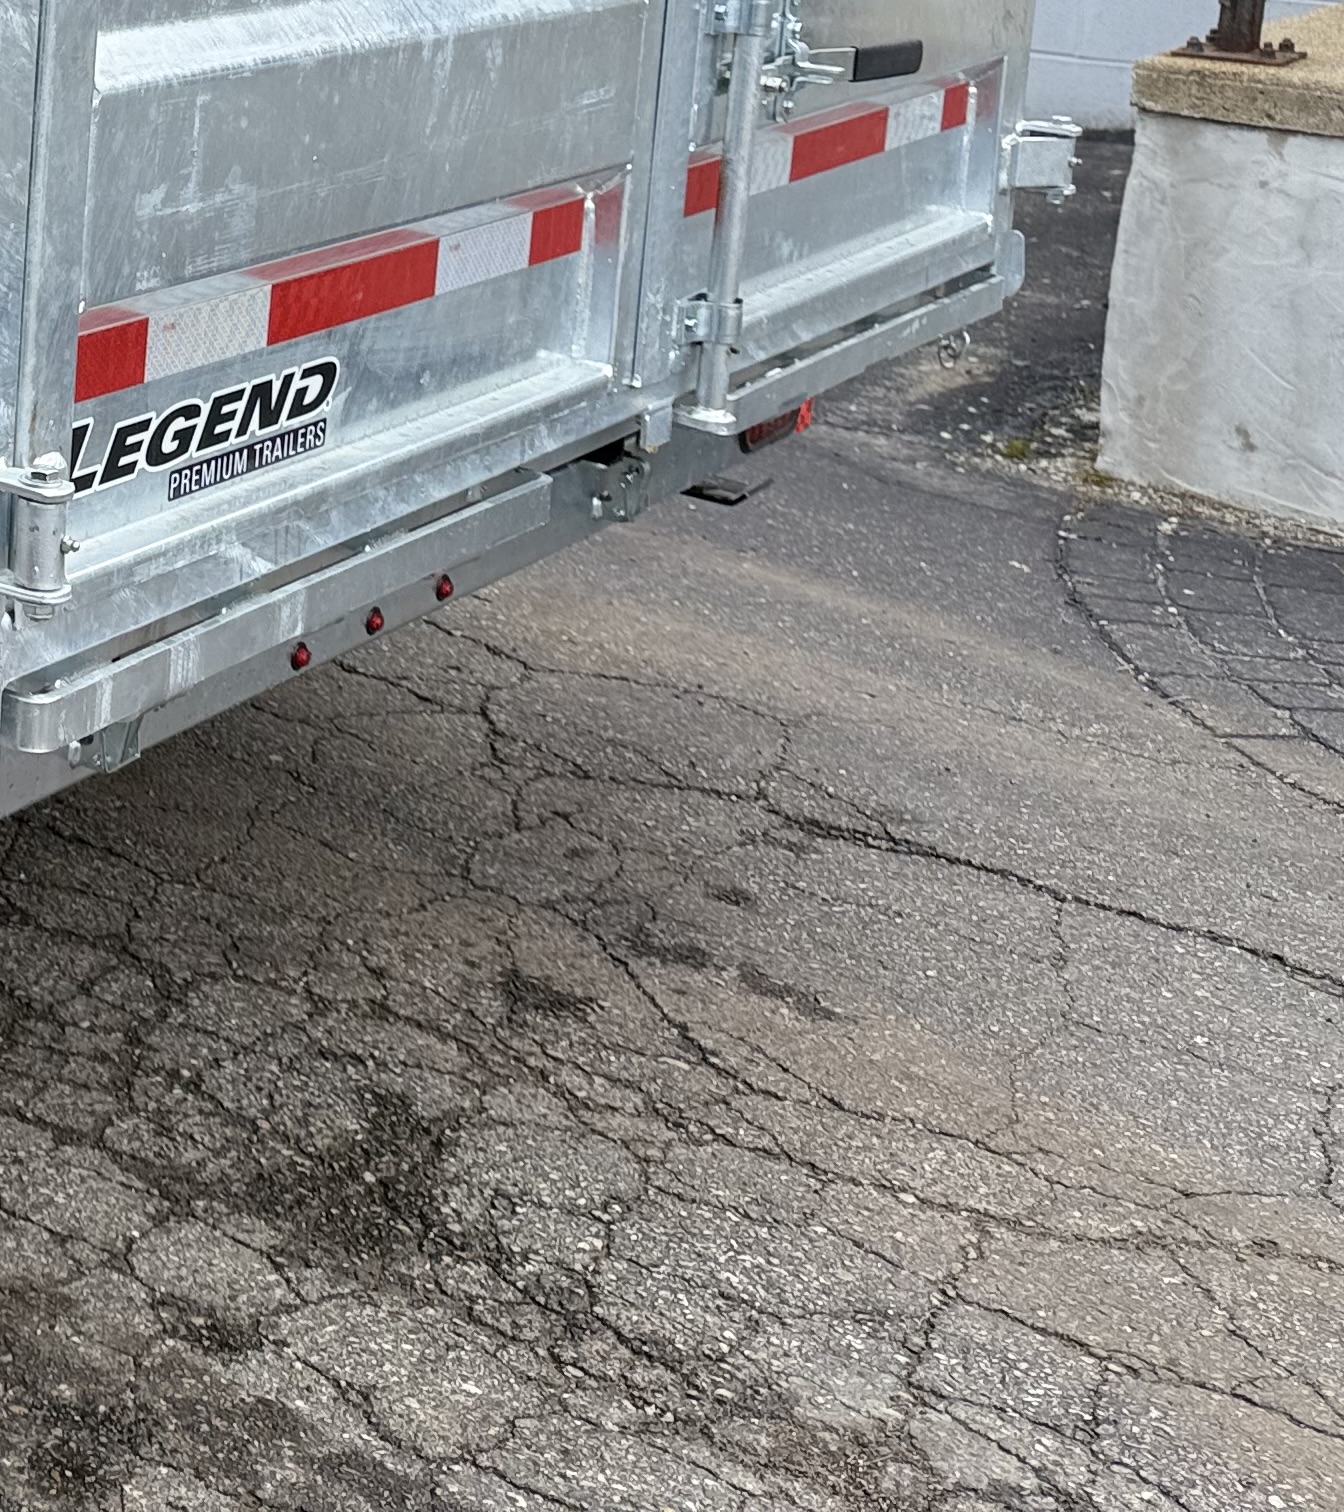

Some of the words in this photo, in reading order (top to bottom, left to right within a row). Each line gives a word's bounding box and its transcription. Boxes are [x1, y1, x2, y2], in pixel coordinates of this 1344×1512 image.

[72, 358, 339, 498] LEGEND
[170, 450, 249, 497] PREMIUM
[253, 421, 325, 466] TRAILERS
